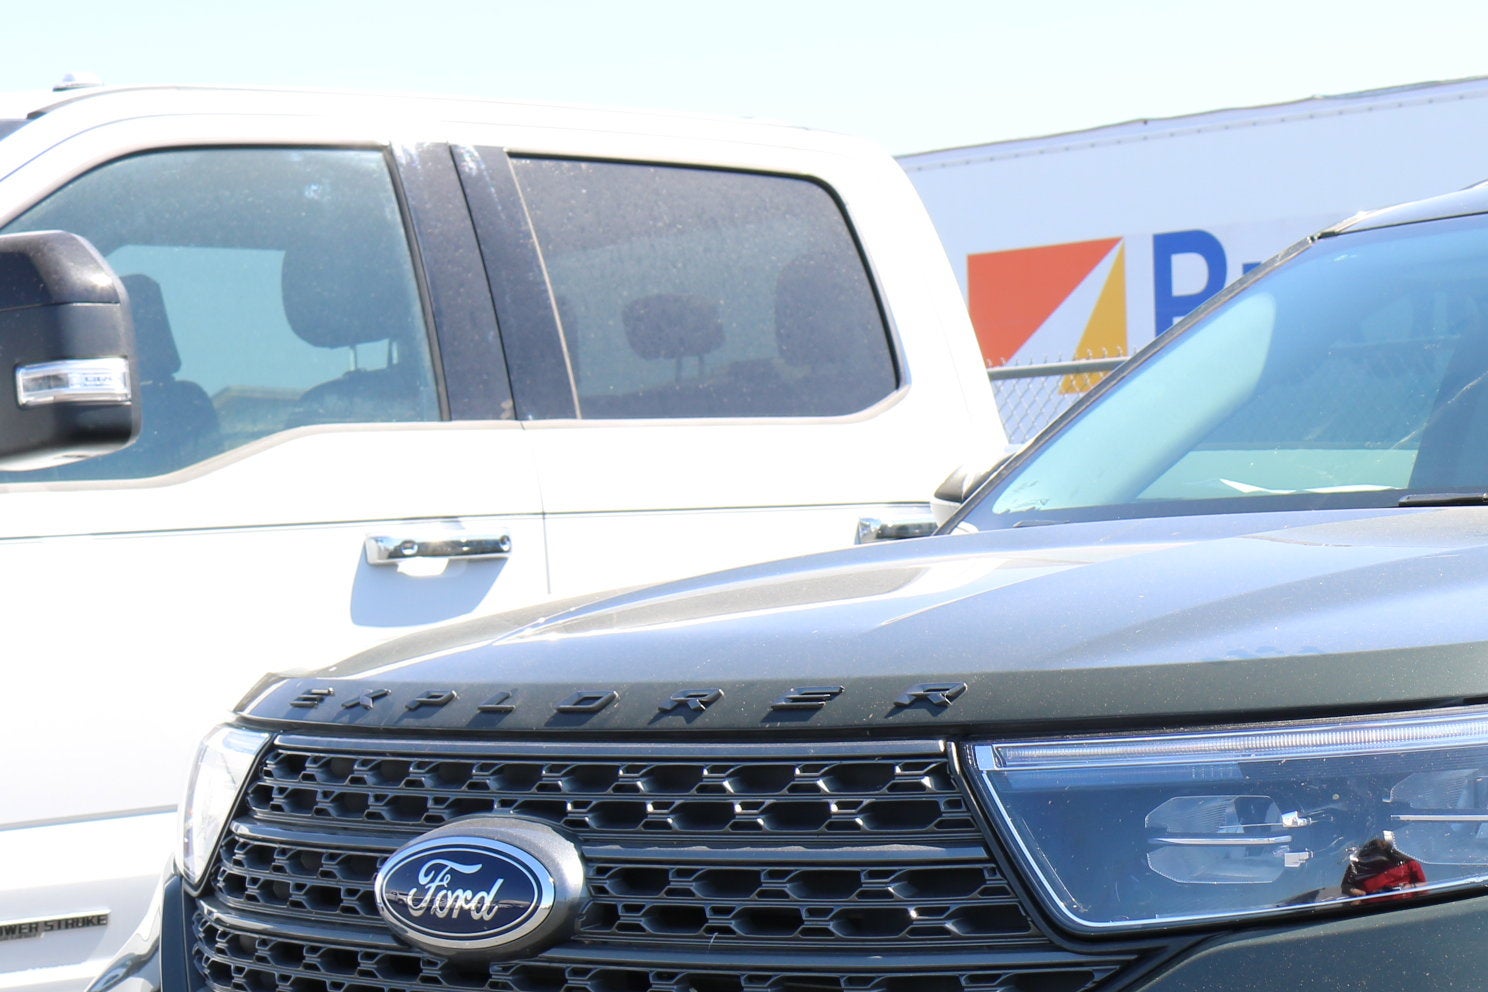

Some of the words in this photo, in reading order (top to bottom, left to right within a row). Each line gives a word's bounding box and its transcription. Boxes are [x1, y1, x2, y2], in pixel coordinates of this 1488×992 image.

[1153, 229, 1264, 337] P
[290, 681, 968, 713] EXPLORER
[407, 858, 504, 921] Ford
[0, 922, 39, 937] WER
[43, 914, 108, 932] STROKE
